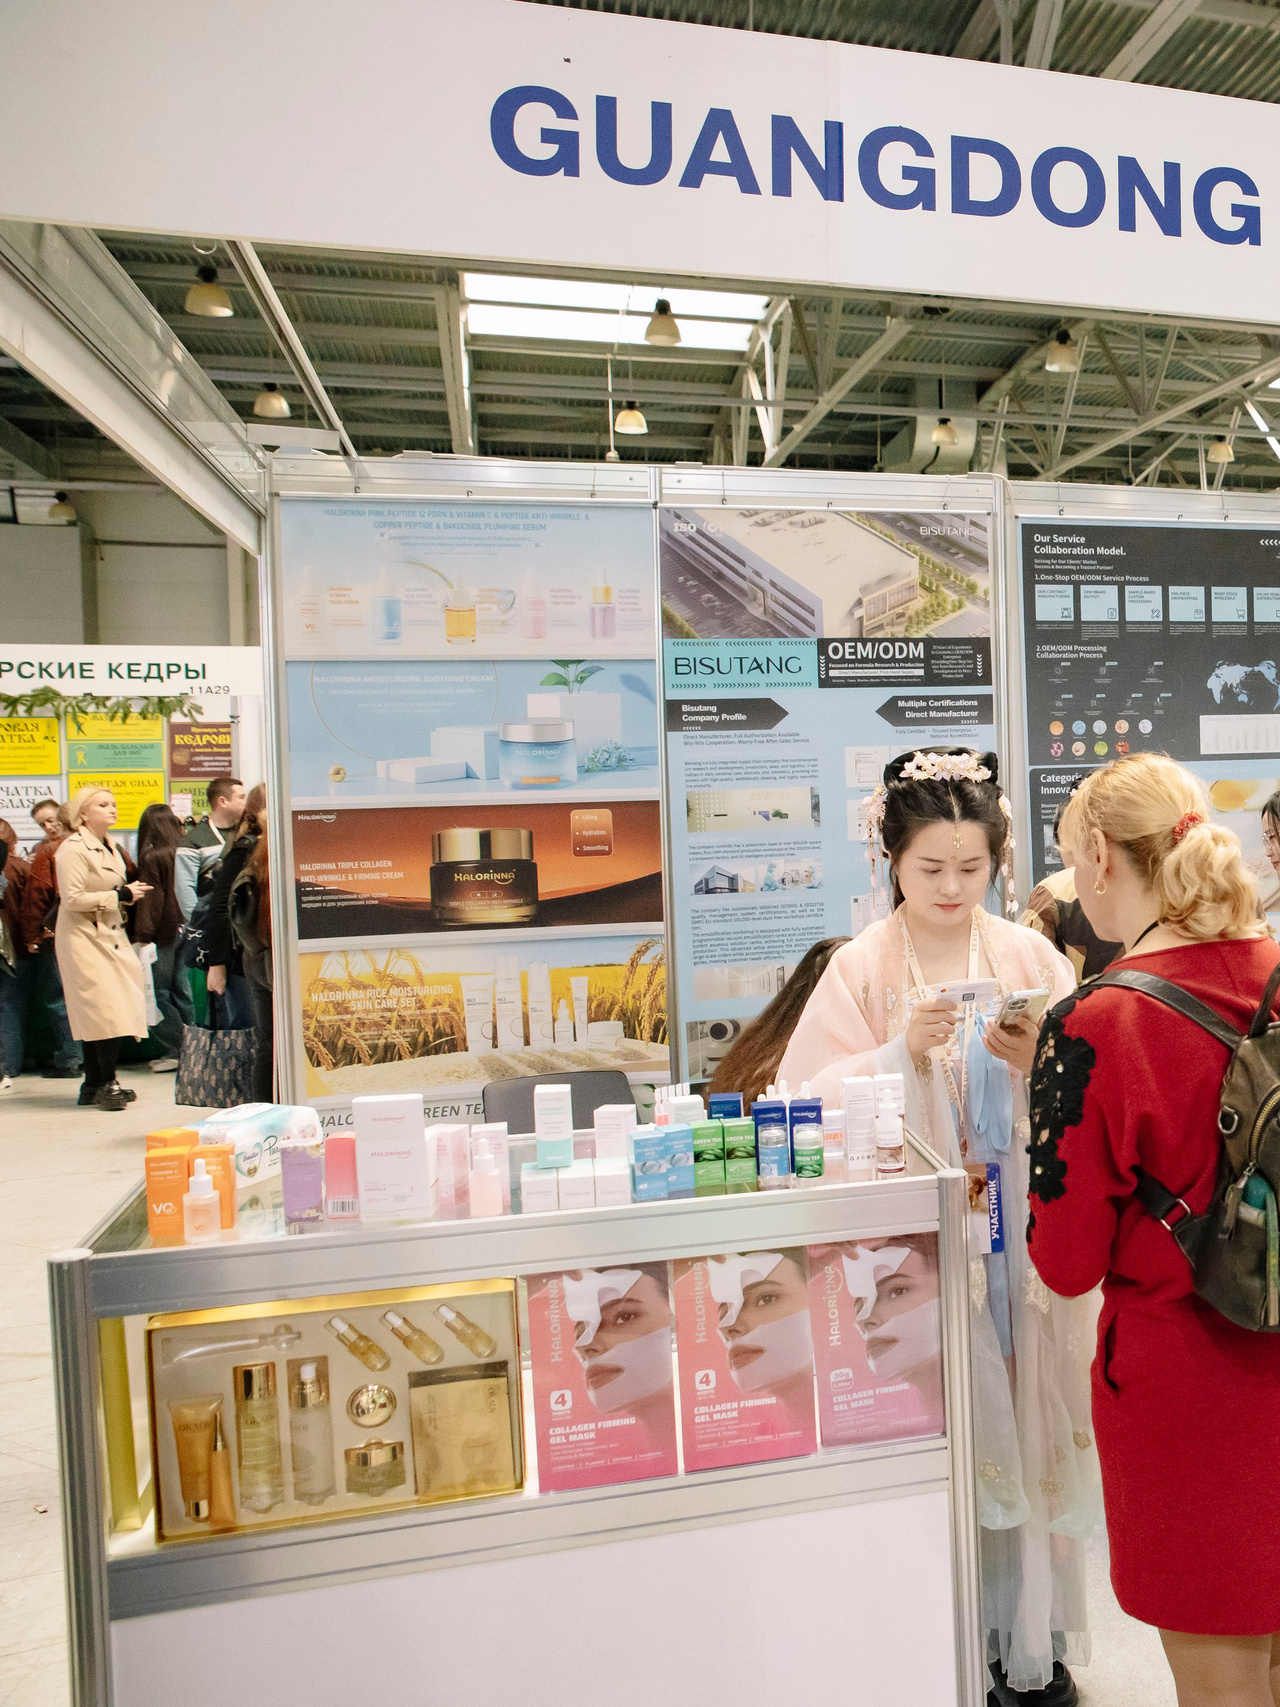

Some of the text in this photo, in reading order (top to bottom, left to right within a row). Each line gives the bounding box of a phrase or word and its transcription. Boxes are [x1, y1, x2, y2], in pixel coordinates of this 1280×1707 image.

[489, 83, 1262, 247] GUANGDONG
[324, 509, 366, 517] HALORINNA
[368, 509, 385, 518] PINK
[387, 509, 417, 519] PEPTIDE
[456, 510, 486, 520] VITAMIN
[501, 512, 530, 520] PEPTIDE
[373, 521, 403, 529] COPPER
[404, 521, 434, 530] PEPTIDE
[442, 522, 482, 531] BAKUCHIOL
[484, 523, 521, 531] PLUMPING
[672, 522, 696, 533] ISO
[919, 525, 975, 537] BISUTANG
[1033, 533, 1086, 544] Our Service
[1034, 545, 1127, 556] Collaboration Model.
[1035, 573, 1070, 582] 1.One-Stop
[1071, 574, 1102, 582] OEM/ODM
[827, 642, 925, 660] OEM/ODM
[1036, 645, 1107, 653] 2.OEM/ODM Processing
[107, 661, 207, 684] КЕДРЫ
[675, 656, 803, 676] BISUTANG
[363, 675, 422, 684] MOISTURIZING
[423, 675, 464, 683] SOOTHING
[465, 675, 494, 683] CREAM
[681, 704, 717, 713] Bisutang
[897, 698, 978, 709] Multiple Certifications
[682, 713, 747, 723] Company Profile
[929, 710, 979, 718] Manufacturer
[582, 829, 607, 838] Hydration
[582, 844, 609, 853] Smoothing
[300, 860, 393, 871] HALORINNA TRIPLE COLLAGEN
[300, 874, 347, 883] ANTI-WRINKLE
[354, 873, 381, 881] FIRMING
[454, 870, 516, 885] HALORINNA
[311, 984, 454, 1003] HALORINNA RICE MOISTURIZING
[351, 1000, 373, 1011] SKIN
[374, 998, 398, 1009] CARE
[989, 1179, 1000, 1241] УЧАСТНИК
[693, 1261, 708, 1345] HALORINNA
[828, 1264, 844, 1347] HALORINNA
[549, 1278, 564, 1364] HALORINNA
[699, 1372, 712, 1386] 4
[554, 1392, 568, 1407] 4
[832, 1383, 911, 1404] COLLAGEN FIRMING
[694, 1396, 777, 1415] COLLAGEN FIRMING
[833, 1399, 875, 1412] GEL MASK
[694, 1410, 739, 1424] GEL MASK
[549, 1416, 637, 1436] COLLAGEN FIRMING
[550, 1431, 597, 1445] GEL MASK
